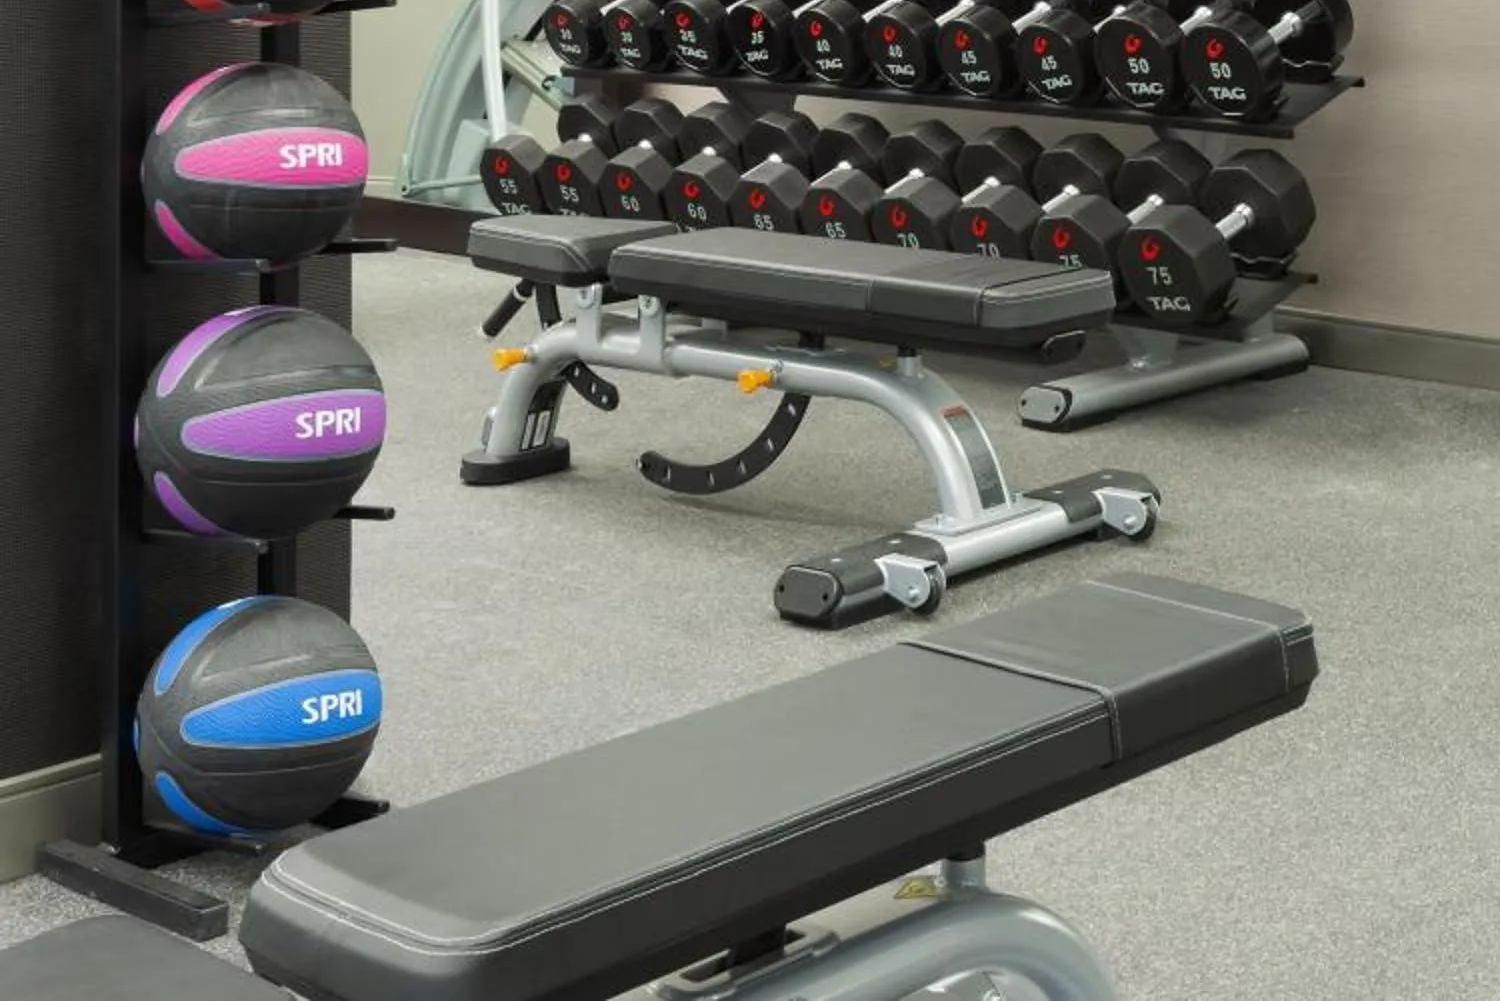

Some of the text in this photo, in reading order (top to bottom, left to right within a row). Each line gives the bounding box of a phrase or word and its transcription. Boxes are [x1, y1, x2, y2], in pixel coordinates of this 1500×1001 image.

[676, 43, 709, 60] TAG
[745, 49, 769, 63] TAG
[815, 57, 844, 71] TAG
[884, 63, 916, 77] TAG
[1127, 57, 1150, 74] 50
[1209, 62, 1232, 80] 50
[960, 70, 991, 84] TAG
[1041, 74, 1073, 91] TAG
[1125, 81, 1166, 96] TAG
[1207, 85, 1247, 101] TAG
[279, 141, 343, 169] SPRI
[499, 178, 518, 195] 55
[559, 184, 580, 203] 55
[620, 194, 640, 213] 60
[687, 202, 708, 221] 60
[754, 213, 776, 232] 65
[825, 221, 847, 240] 65
[896, 232, 920, 249] 70
[976, 242, 1000, 259] 70
[1058, 254, 1083, 270] 75
[1145, 265, 1173, 287] 75
[1148, 296, 1191, 312] TAG
[295, 406, 361, 439] SPRI
[302, 689, 362, 725] SPRI
